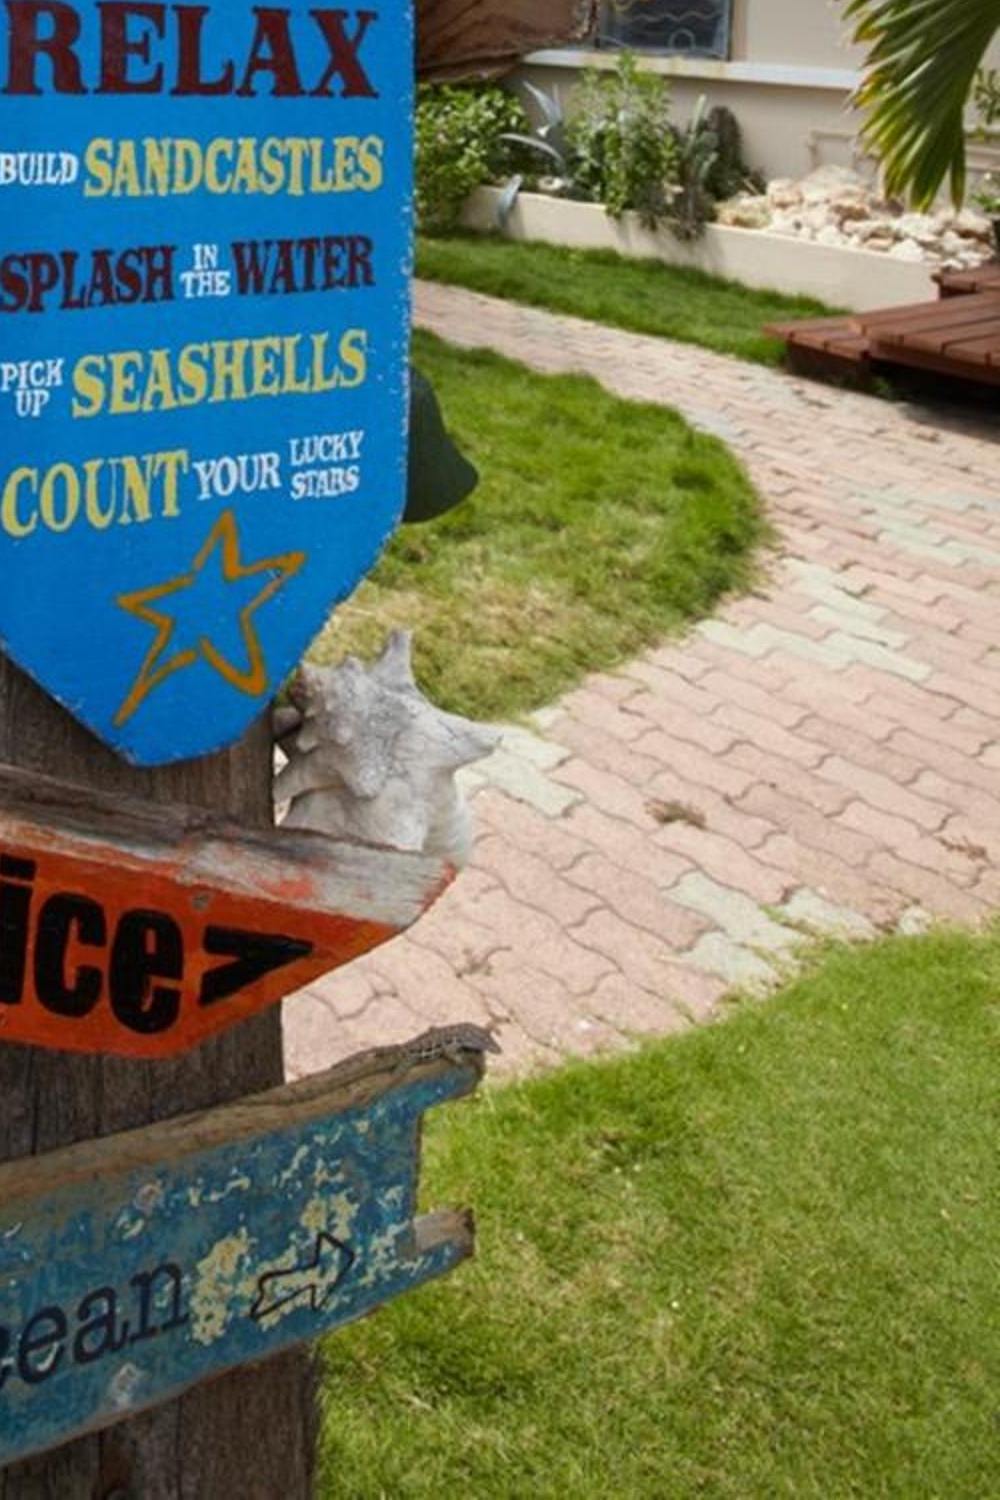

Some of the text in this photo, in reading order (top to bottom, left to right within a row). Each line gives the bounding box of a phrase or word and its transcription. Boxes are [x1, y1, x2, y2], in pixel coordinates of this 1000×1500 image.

[83, 135, 385, 197] SANDCASTLES
[193, 244, 219, 271] IN
[231, 235, 377, 296] WATER
[180, 271, 231, 299] THE
[0, 358, 64, 392] PICK
[71, 328, 368, 419] SEASHELLS
[15, 389, 50, 417] UP
[289, 430, 364, 466] LUCKY
[0, 449, 281, 538] COUNT YOUR
[290, 465, 361, 501] STARS
